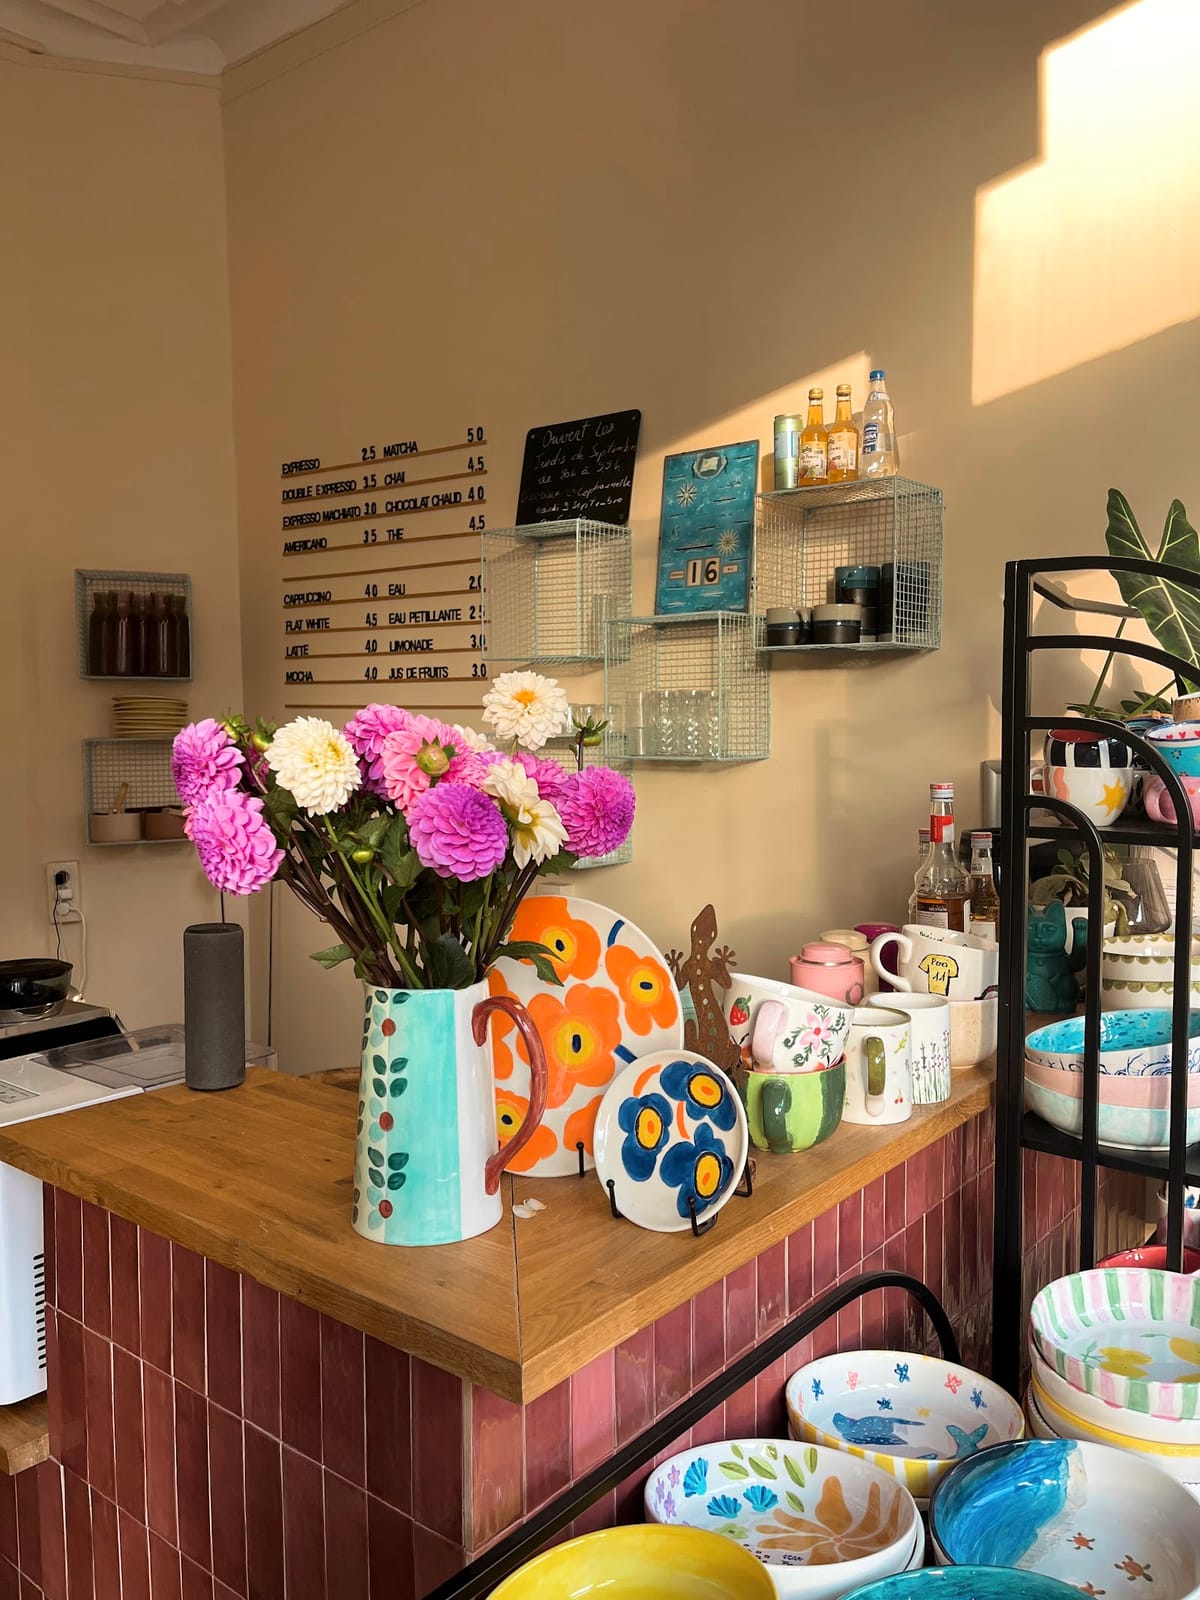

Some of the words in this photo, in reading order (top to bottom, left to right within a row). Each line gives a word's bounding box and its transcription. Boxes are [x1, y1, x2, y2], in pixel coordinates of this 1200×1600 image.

[383, 441, 418, 458] MATCHA
[282, 458, 321, 475] EXPRESSO
[361, 445, 377, 462] 2.5
[384, 471, 405, 486] CHAI
[467, 456, 484, 472] 4.5
[282, 486, 313, 501] DOUBLE
[315, 480, 357, 496] EXPRESSO
[362, 473, 377, 490] 3.5
[385, 496, 430, 513] CHOCOLAT
[431, 491, 462, 507] CHAUD
[283, 511, 321, 528] EXPRESSO
[386, 528, 404, 541] THE
[469, 514, 485, 531] 4.5
[283, 537, 328, 553] AMERICANO
[691, 560, 718, 583] 16
[283, 590, 332, 605] CAPPUCCINO
[388, 583, 406, 596] EAU
[285, 619, 304, 632] FLAT
[305, 617, 330, 630] WHITE
[388, 612, 406, 625] EAU
[408, 608, 462, 624] PETILLANTE
[286, 644, 309, 657] LATTE
[389, 638, 434, 653] LIMONADE
[286, 671, 314, 684] MOCHA
[389, 667, 404, 680] JUS
[406, 667, 418, 680] DE
[418, 666, 449, 679] FRUITS
[471, 663, 487, 678] 3.0
